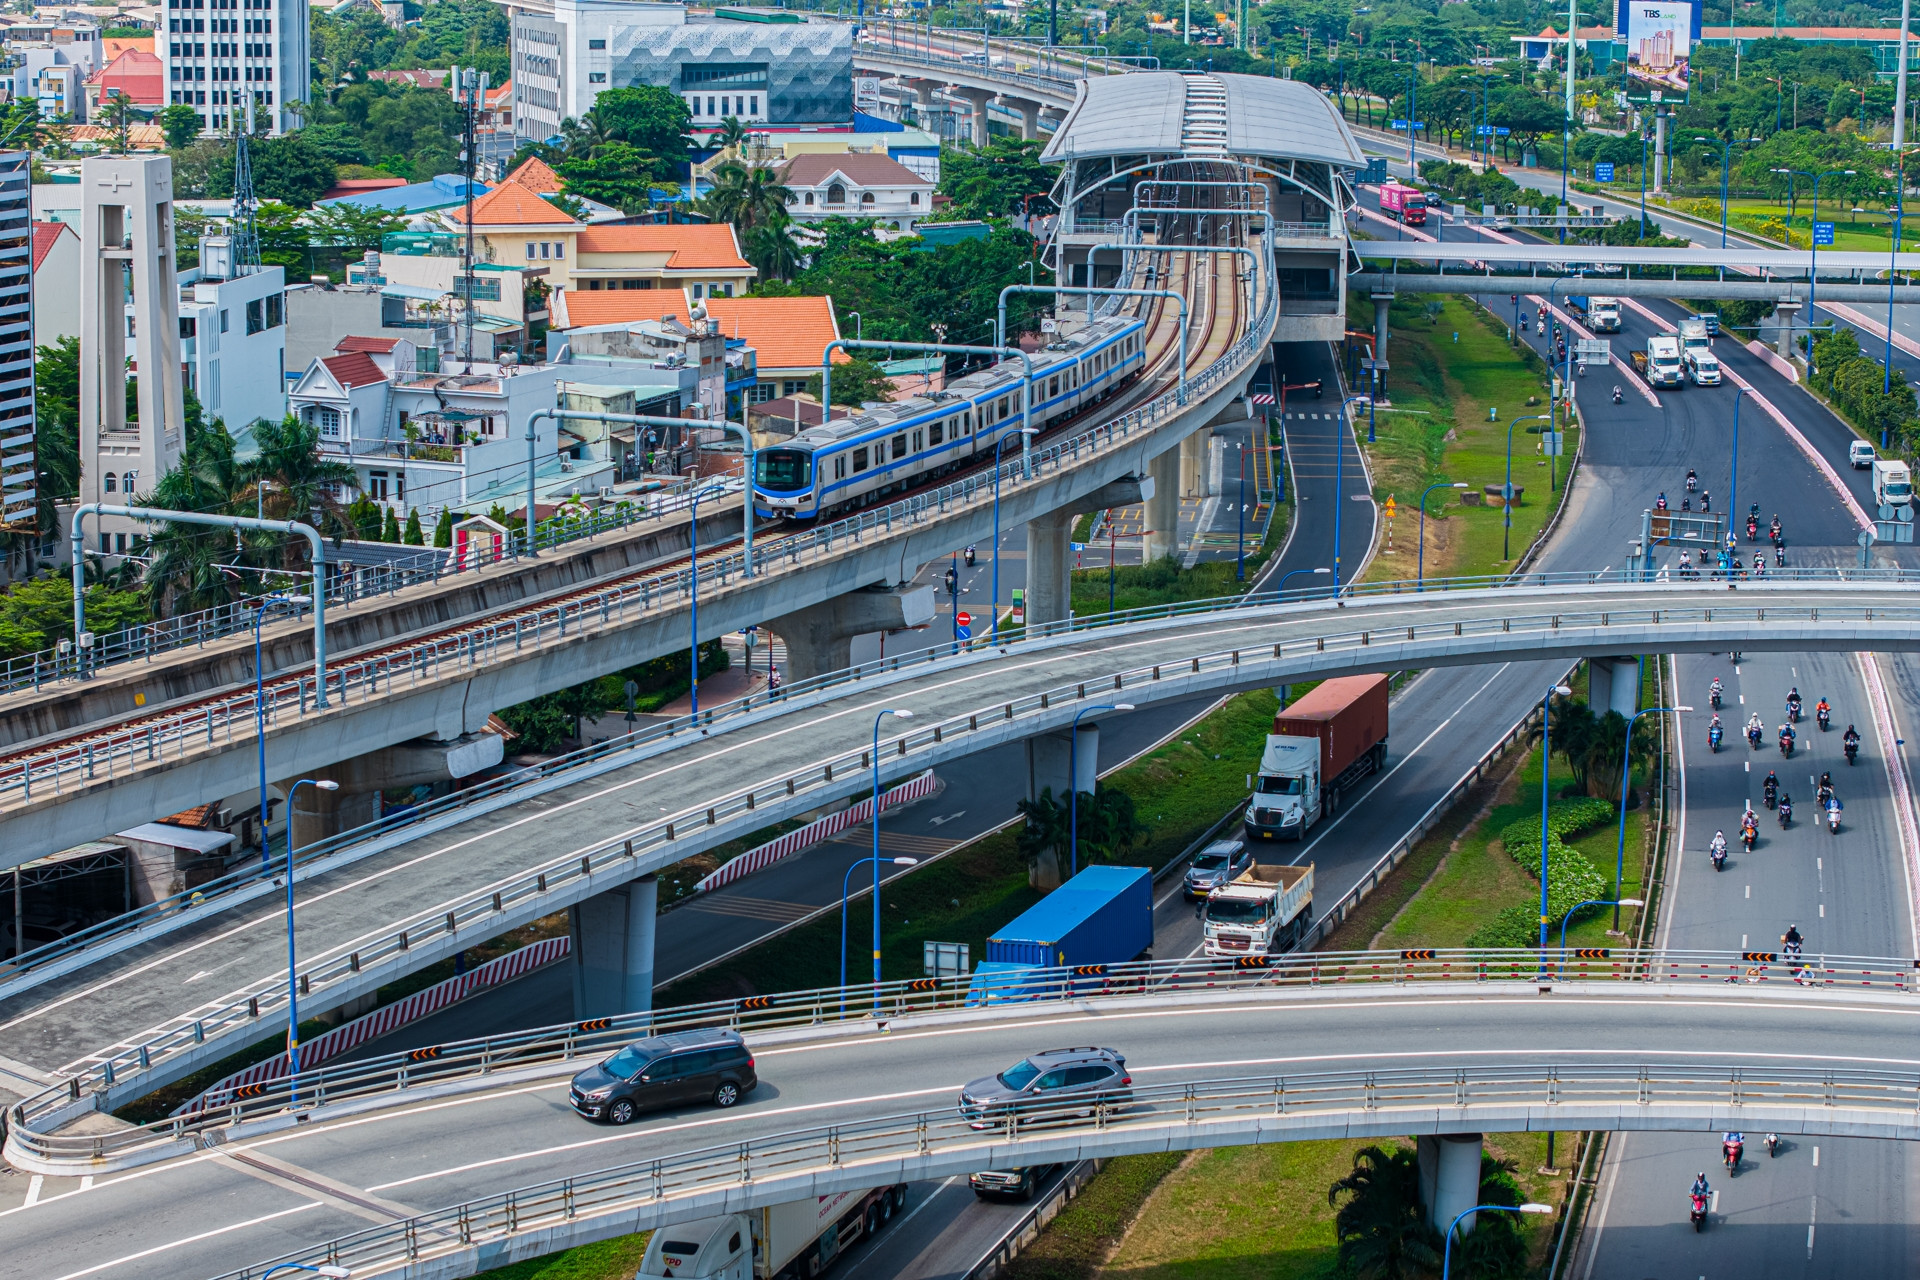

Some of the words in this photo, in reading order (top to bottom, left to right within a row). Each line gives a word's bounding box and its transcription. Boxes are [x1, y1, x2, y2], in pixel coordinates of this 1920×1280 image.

[1643, 9, 1660, 18] TBS
[1381, 189, 1389, 201] ONE
[1391, 192, 1399, 204] ONE
[818, 1203, 832, 1218] OCEAN
